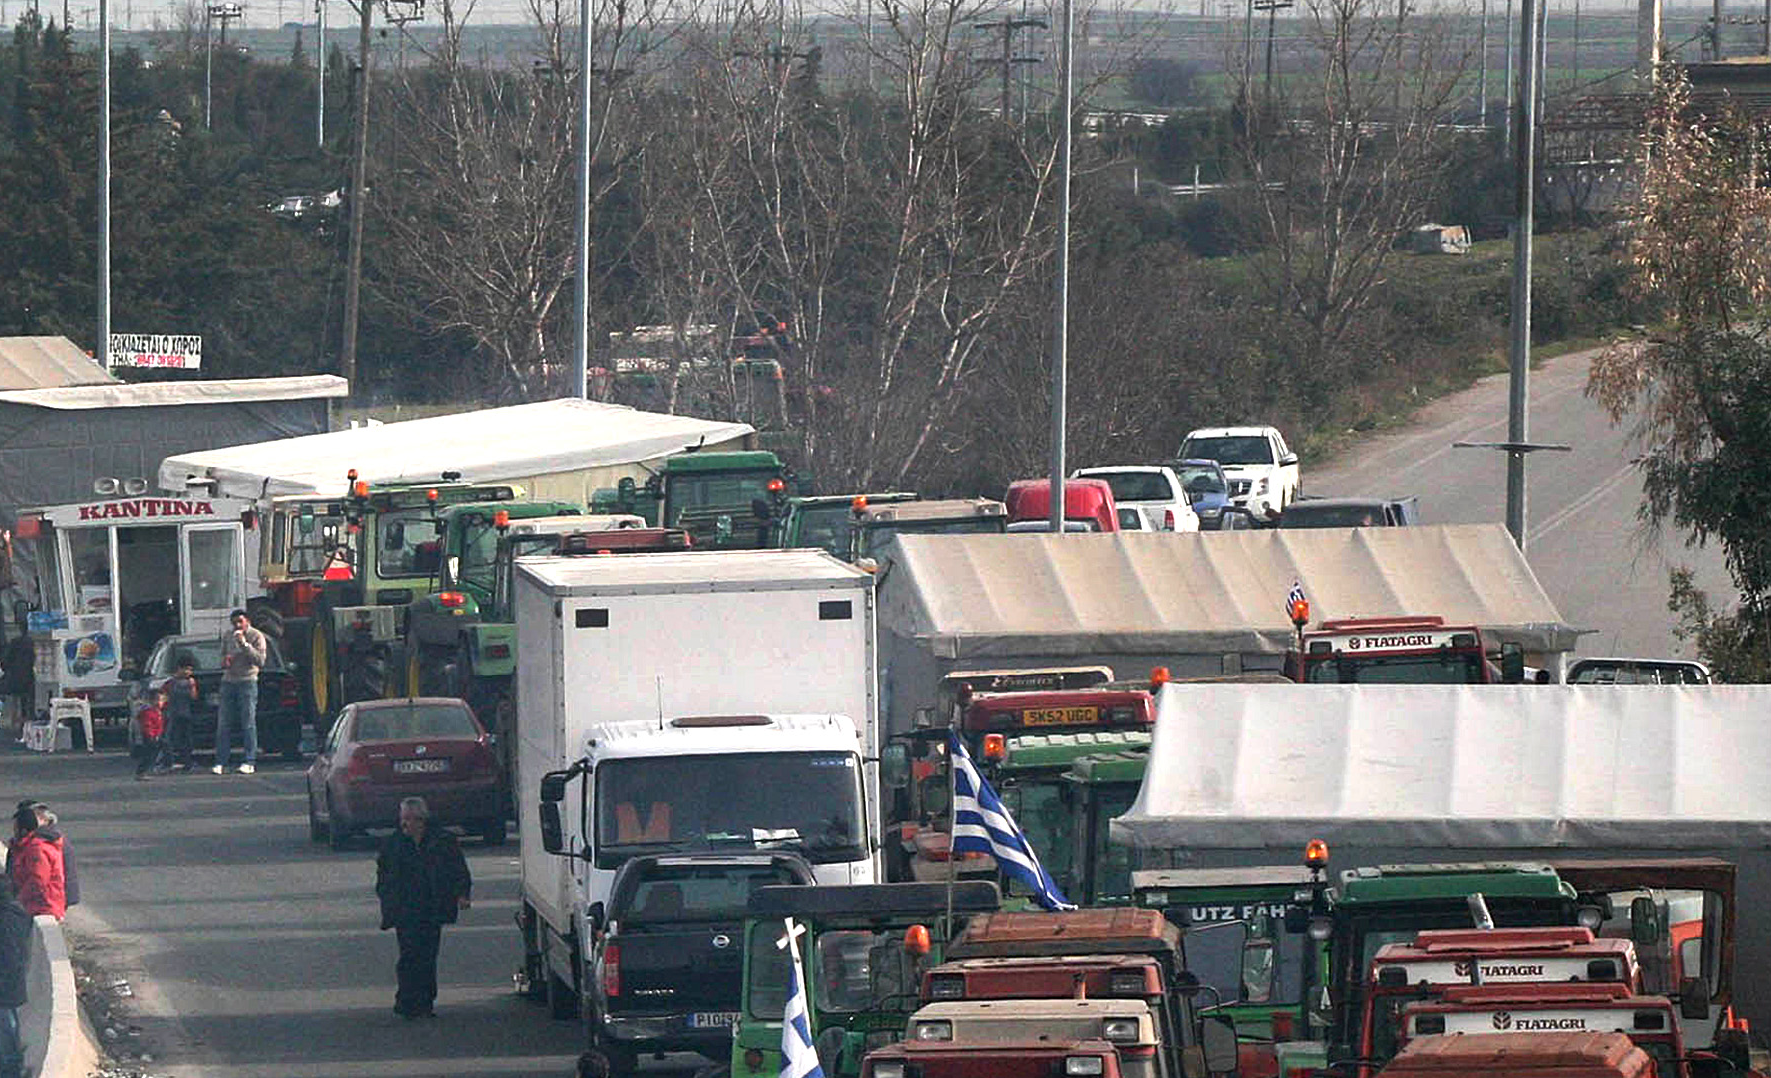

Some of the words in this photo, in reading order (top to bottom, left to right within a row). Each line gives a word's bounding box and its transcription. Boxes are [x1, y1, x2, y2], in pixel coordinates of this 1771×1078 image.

[171, 336, 200, 355] ΧΩΡΟΣ
[79, 499, 213, 520] KANTINA
[1365, 635, 1432, 648] FIATAGRI
[1242, 903, 1294, 919] FAH
[1516, 1018, 1586, 1030] FIATAGRI
